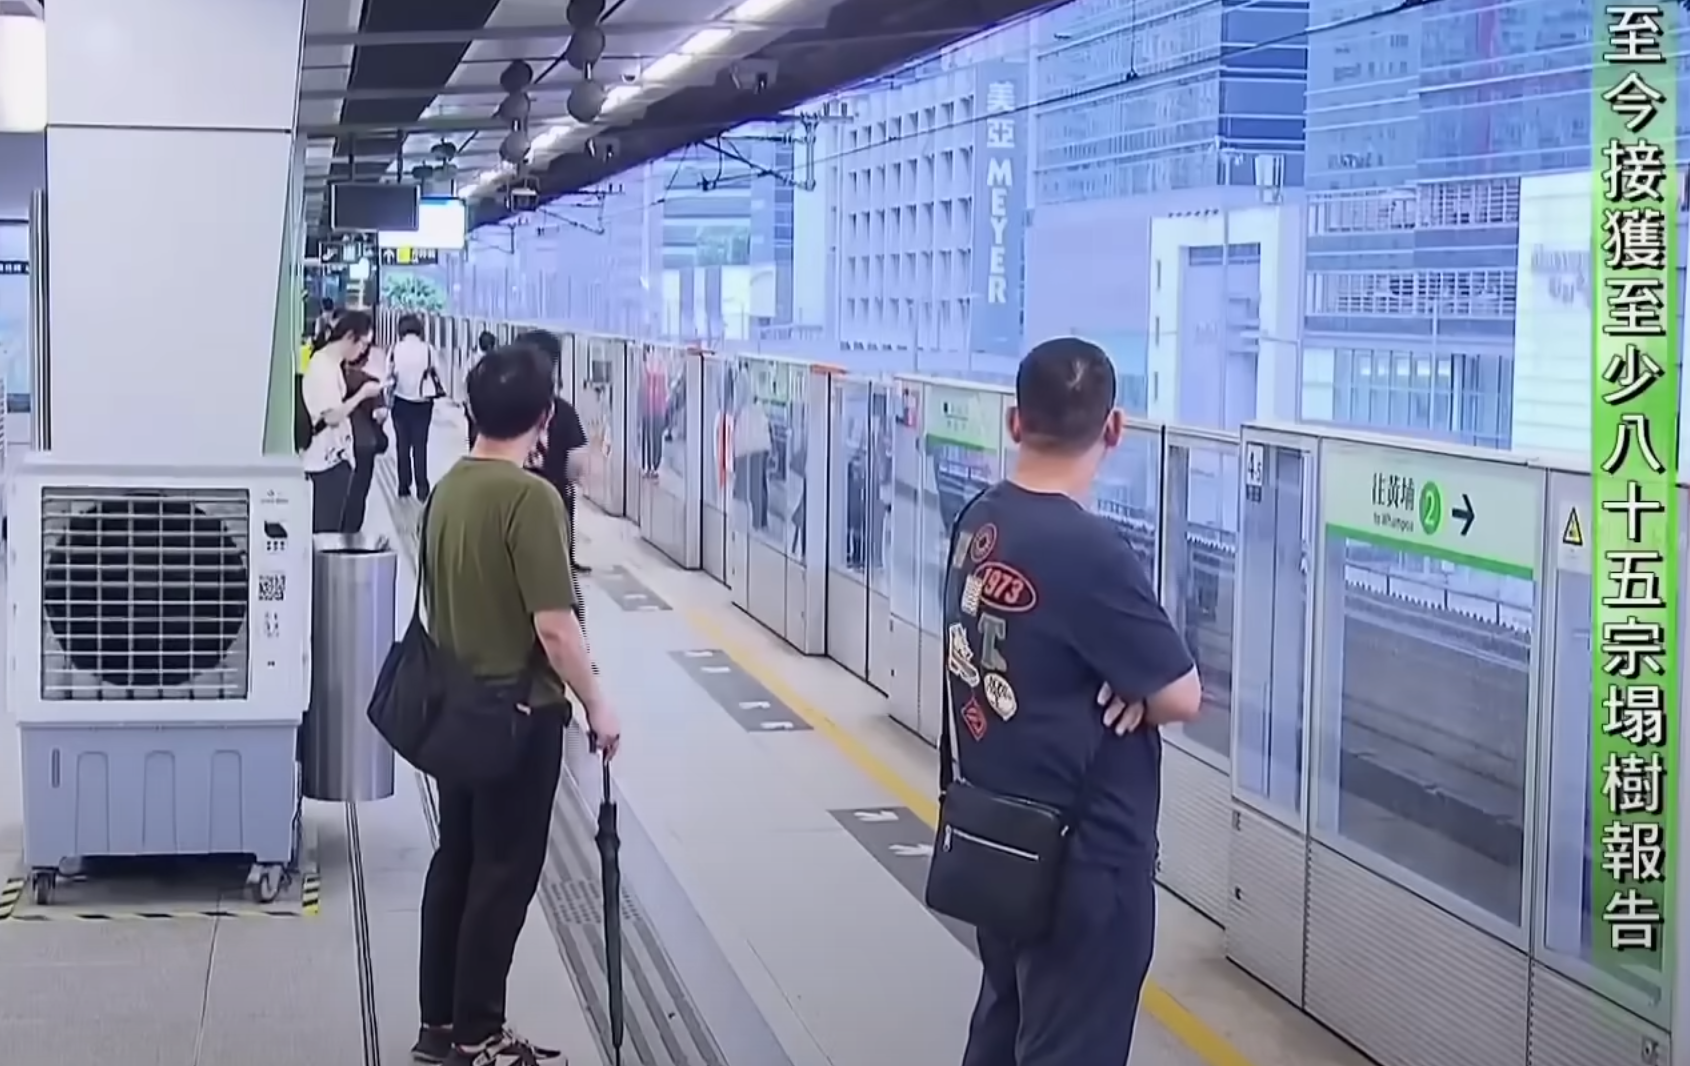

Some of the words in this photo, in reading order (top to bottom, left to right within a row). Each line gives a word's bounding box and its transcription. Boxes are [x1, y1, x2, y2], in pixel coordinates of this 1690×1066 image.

[986, 81, 1015, 148] 美亞
[987, 157, 1013, 304] MEYER
[983, 567, 1024, 604] 1973
